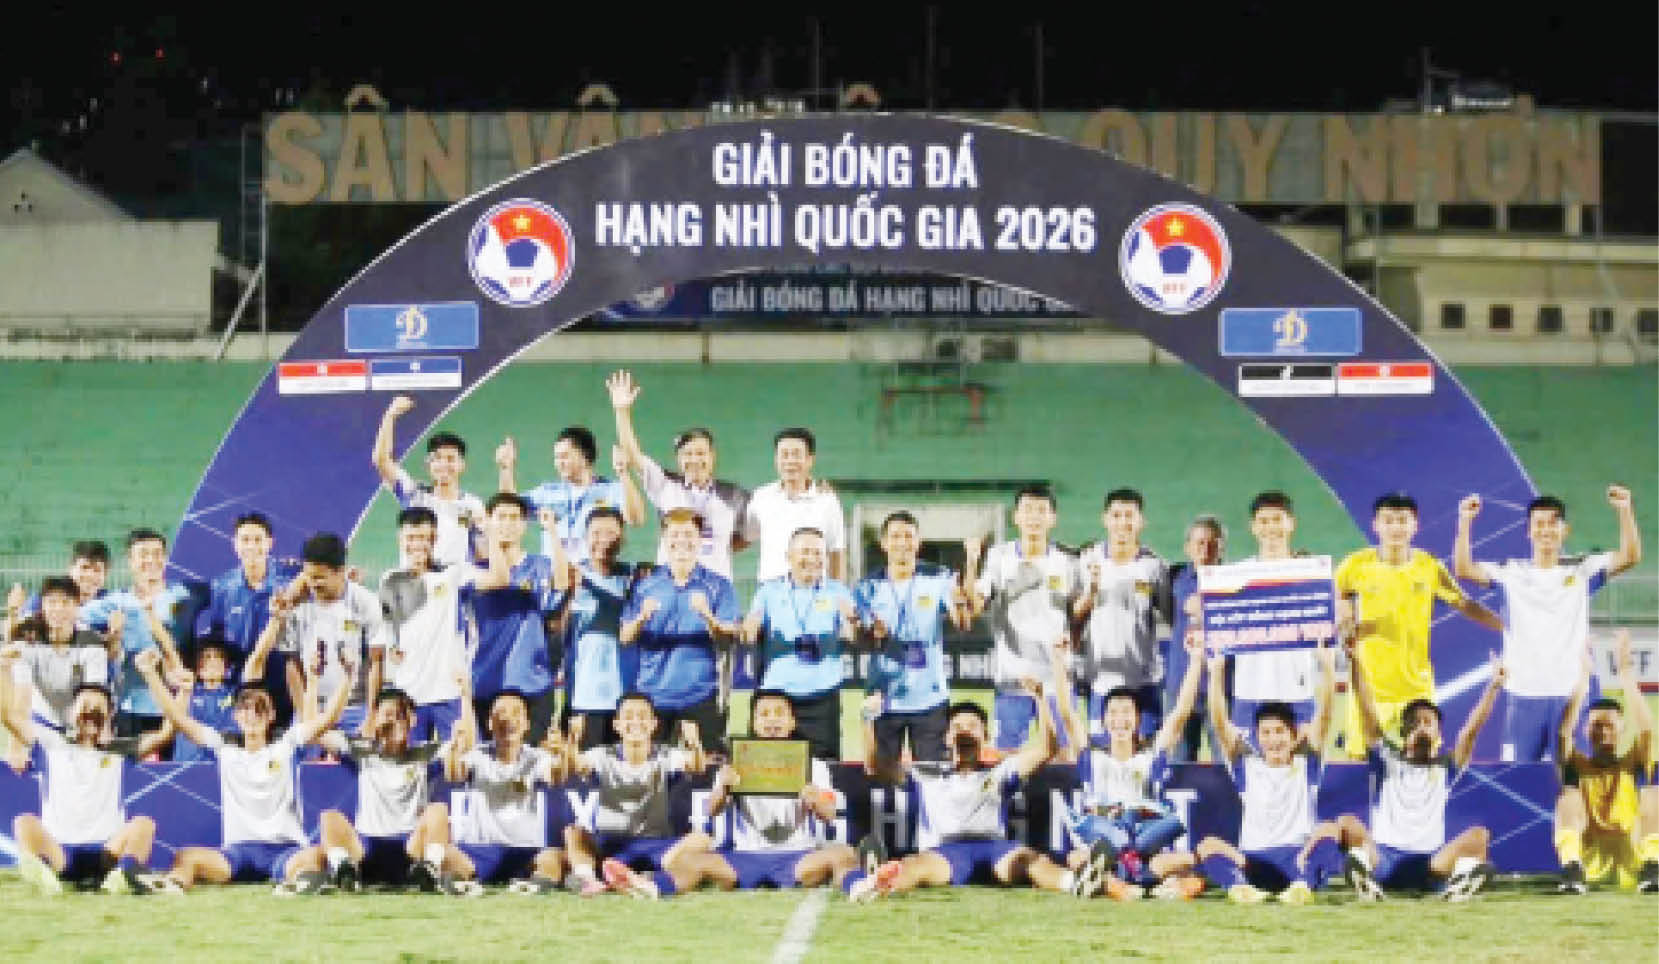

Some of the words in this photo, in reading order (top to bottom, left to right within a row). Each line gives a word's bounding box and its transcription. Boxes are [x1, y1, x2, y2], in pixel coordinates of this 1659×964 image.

[713, 131, 792, 186] GIẢI
[804, 132, 913, 187] BÓNG
[923, 131, 978, 188] ĐÁ
[595, 202, 703, 257] HẠNG
[714, 190, 782, 247] NHÌ
[794, 190, 905, 255] QUỐC
[916, 204, 984, 250] GIA
[995, 204, 1098, 252] 2026
